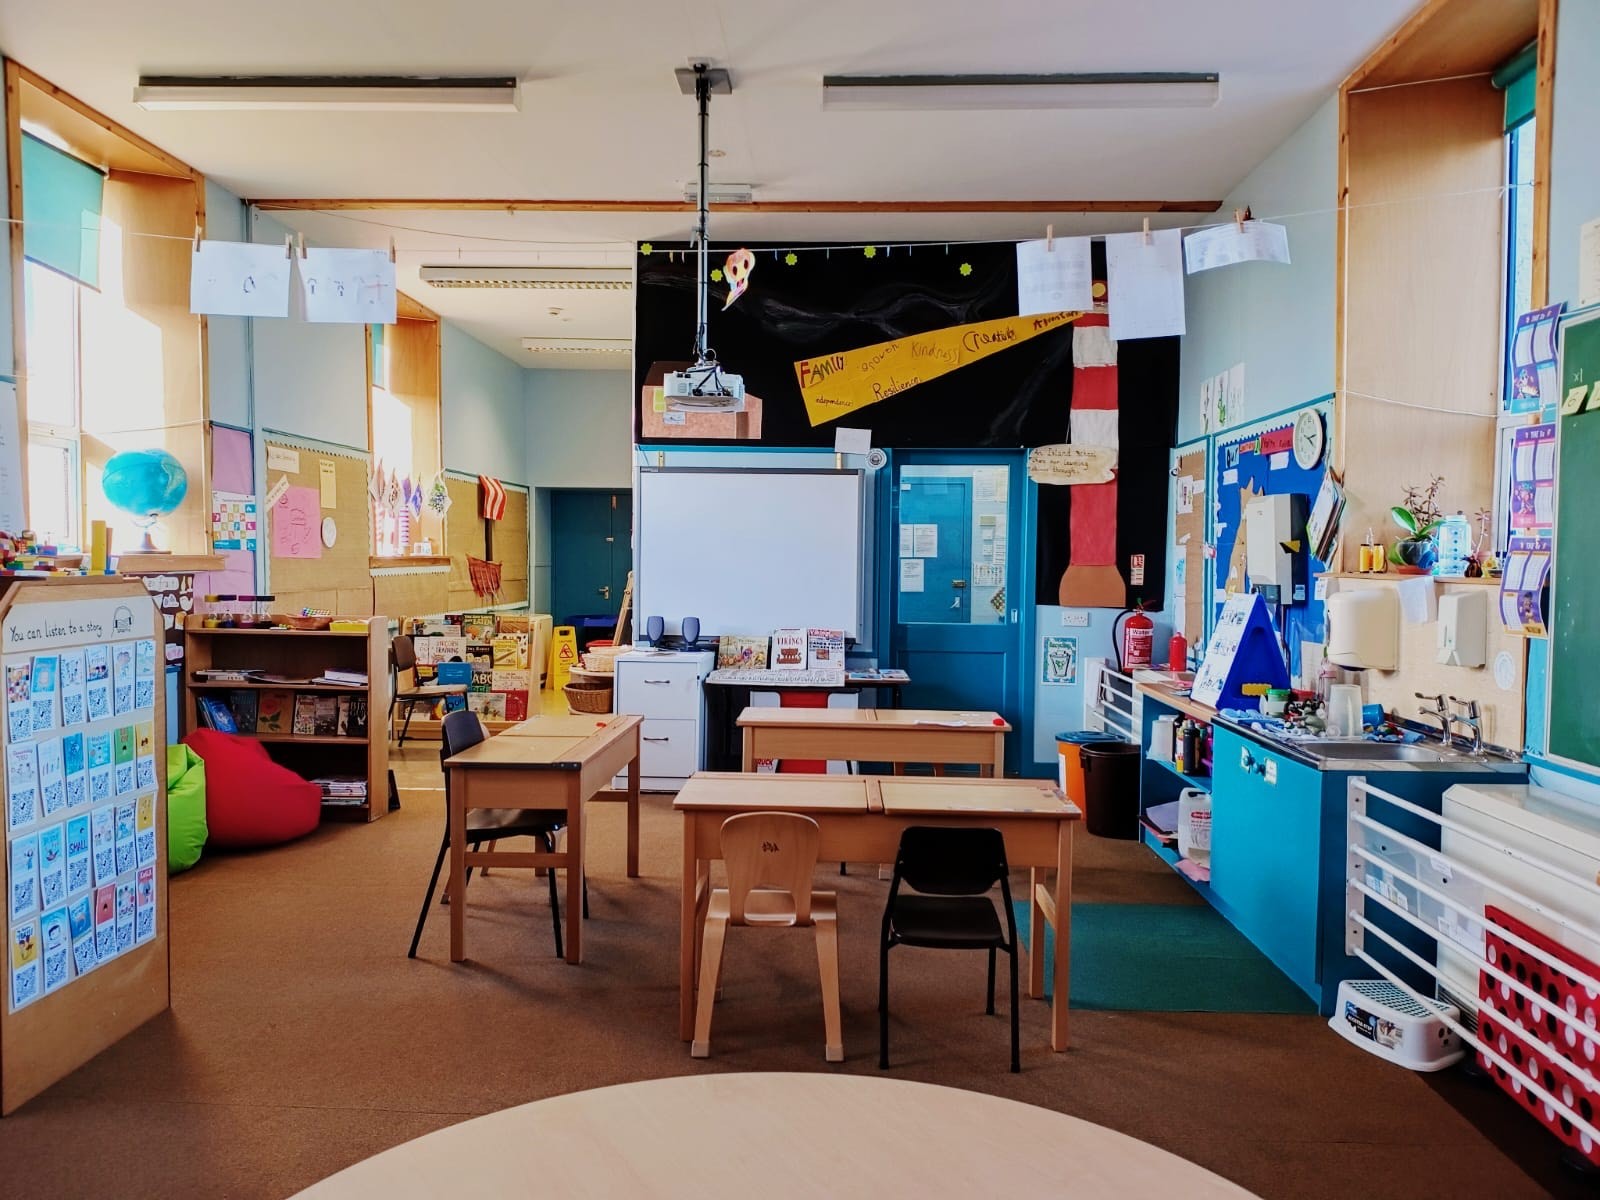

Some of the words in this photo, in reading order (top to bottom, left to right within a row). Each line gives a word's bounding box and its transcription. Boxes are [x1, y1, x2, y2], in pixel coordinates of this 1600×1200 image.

[10, 625, 24, 642] You
[27, 628, 42, 640] can
[44, 618, 66, 638] listen
[68, 618, 77, 634] to
[86, 620, 103, 638] story
